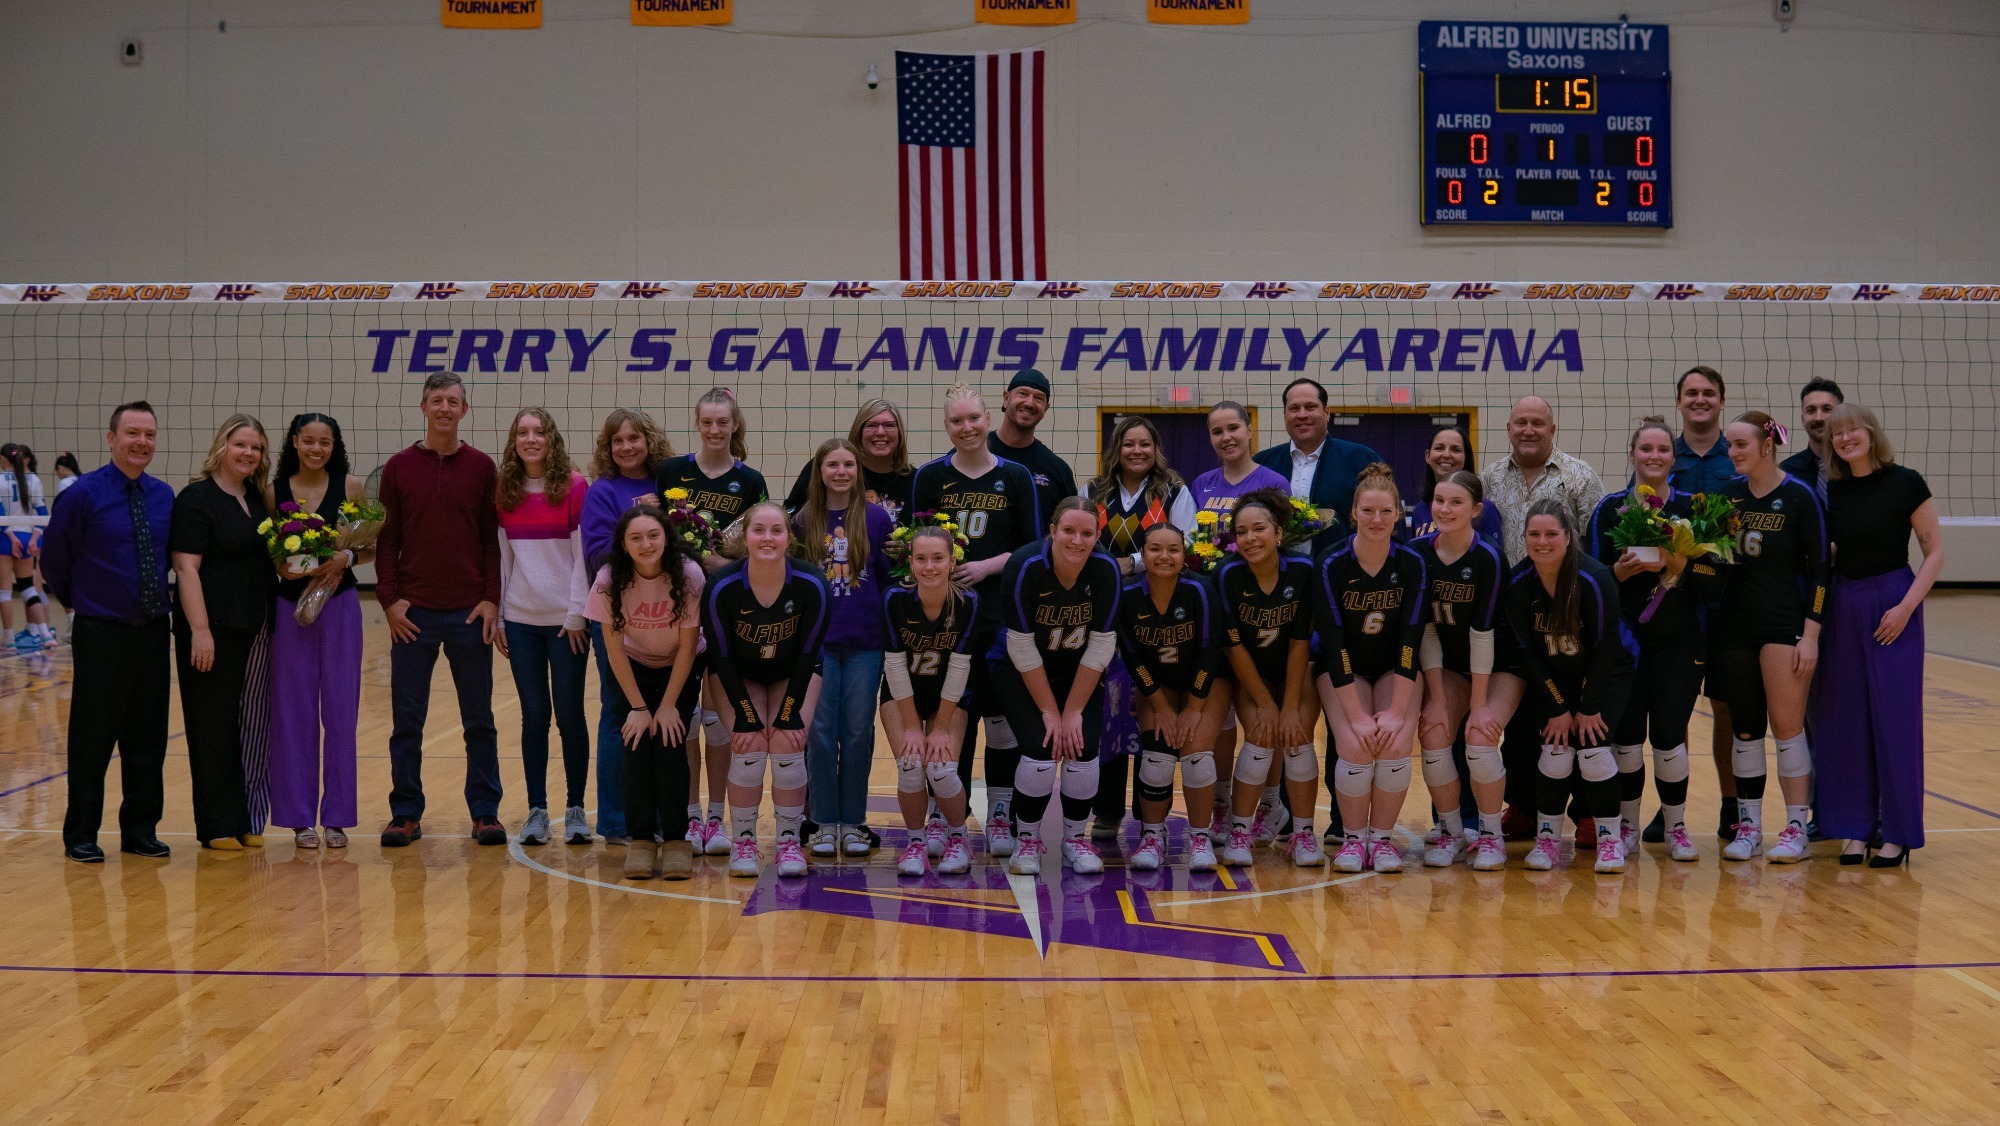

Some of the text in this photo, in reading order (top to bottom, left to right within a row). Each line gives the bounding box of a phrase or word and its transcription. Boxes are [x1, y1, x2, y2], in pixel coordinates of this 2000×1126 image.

[447, 0, 537, 14] TOURNAMENT
[635, 0, 725, 11] TOURNAMENT
[980, 0, 1071, 9] TOURNAMENT
[1154, 0, 1242, 10] TOURNAMENT
[1437, 26, 1653, 51] ALFRED UNIVERSITY
[1507, 51, 1585, 69] Saxons
[1535, 78, 1591, 109] 1:15
[1436, 114, 1491, 129] ALFRED
[1530, 123, 1564, 134] PERIOD
[1607, 116, 1652, 131] GUEST
[1470, 134, 1488, 164] 0
[1549, 139, 1555, 161] 1
[1636, 136, 1653, 167] 0
[1436, 168, 1467, 179] FOULS
[1477, 168, 1504, 179] T.O.L.
[1516, 169, 1581, 180] PLAYER FOUL
[1589, 169, 1616, 180] T.O.L.
[1627, 170, 1657, 181] FOULS
[1448, 180, 1462, 204] 0
[1484, 181, 1498, 205] 2
[1596, 182, 1610, 206] 2
[1639, 182, 1653, 206] 0
[1436, 209, 1467, 220] SCORE
[1531, 210, 1564, 221] MATCH
[1627, 211, 1658, 222] SCORE
[20, 285, 64, 301] AU
[86, 284, 193, 300] SAXONS
[214, 284, 259, 300] AU
[283, 284, 394, 300] SAXONS
[415, 282, 461, 299] AU
[485, 282, 599, 299] SAXONS
[620, 282, 668, 299] AU
[692, 282, 807, 299] SAXONS
[829, 281, 876, 298] AU
[901, 281, 1017, 298] SAXONS
[1037, 281, 1085, 298] AU
[1110, 282, 1225, 298] SAXONS
[1246, 282, 1293, 299] AU
[1317, 282, 1432, 299] SAXONS
[1451, 282, 1498, 299] AU
[1523, 283, 1635, 299] SAXONS
[1655, 283, 1700, 300] AU
[1723, 284, 1831, 300] SAXONS
[1852, 284, 1895, 300] AU
[367, 327, 1584, 373] TERRY S. GALANIS FAMILY ARENA
[680, 487, 743, 515] LFRED
[941, 492, 1008, 511] ALFRED
[1204, 497, 1240, 510] ALFR
[956, 509, 989, 539] 10
[1740, 511, 1785, 531] FRED
[1735, 528, 1763, 558] 16
[1432, 579, 1475, 602] FRED
[632, 600, 669, 619] AU
[1035, 601, 1092, 626] ALFRE
[1431, 600, 1457, 626] 11
[1361, 611, 1386, 635] 6
[1047, 625, 1087, 652] 14
[1257, 627, 1280, 648] 7
[910, 650, 942, 676] 12
[1158, 646, 1180, 664] 2
